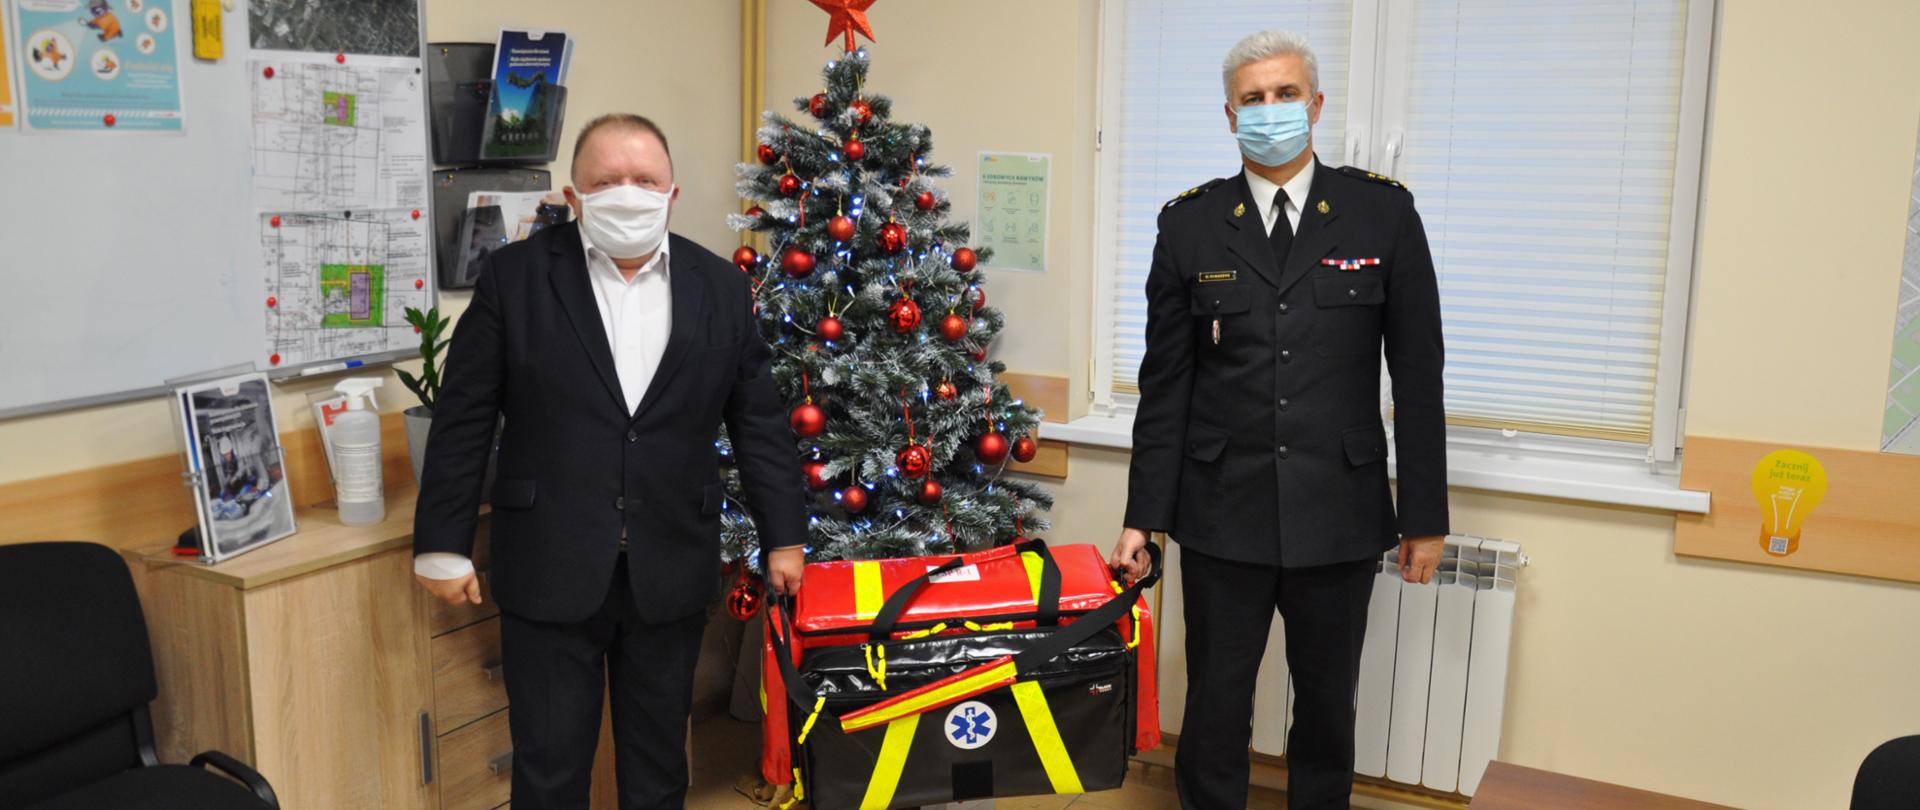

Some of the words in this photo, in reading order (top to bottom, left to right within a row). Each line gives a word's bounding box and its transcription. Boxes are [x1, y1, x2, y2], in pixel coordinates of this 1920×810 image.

[1776, 460, 1808, 473] Zacznij
[1769, 468, 1784, 480] już
[1787, 471, 1811, 481] teraz
